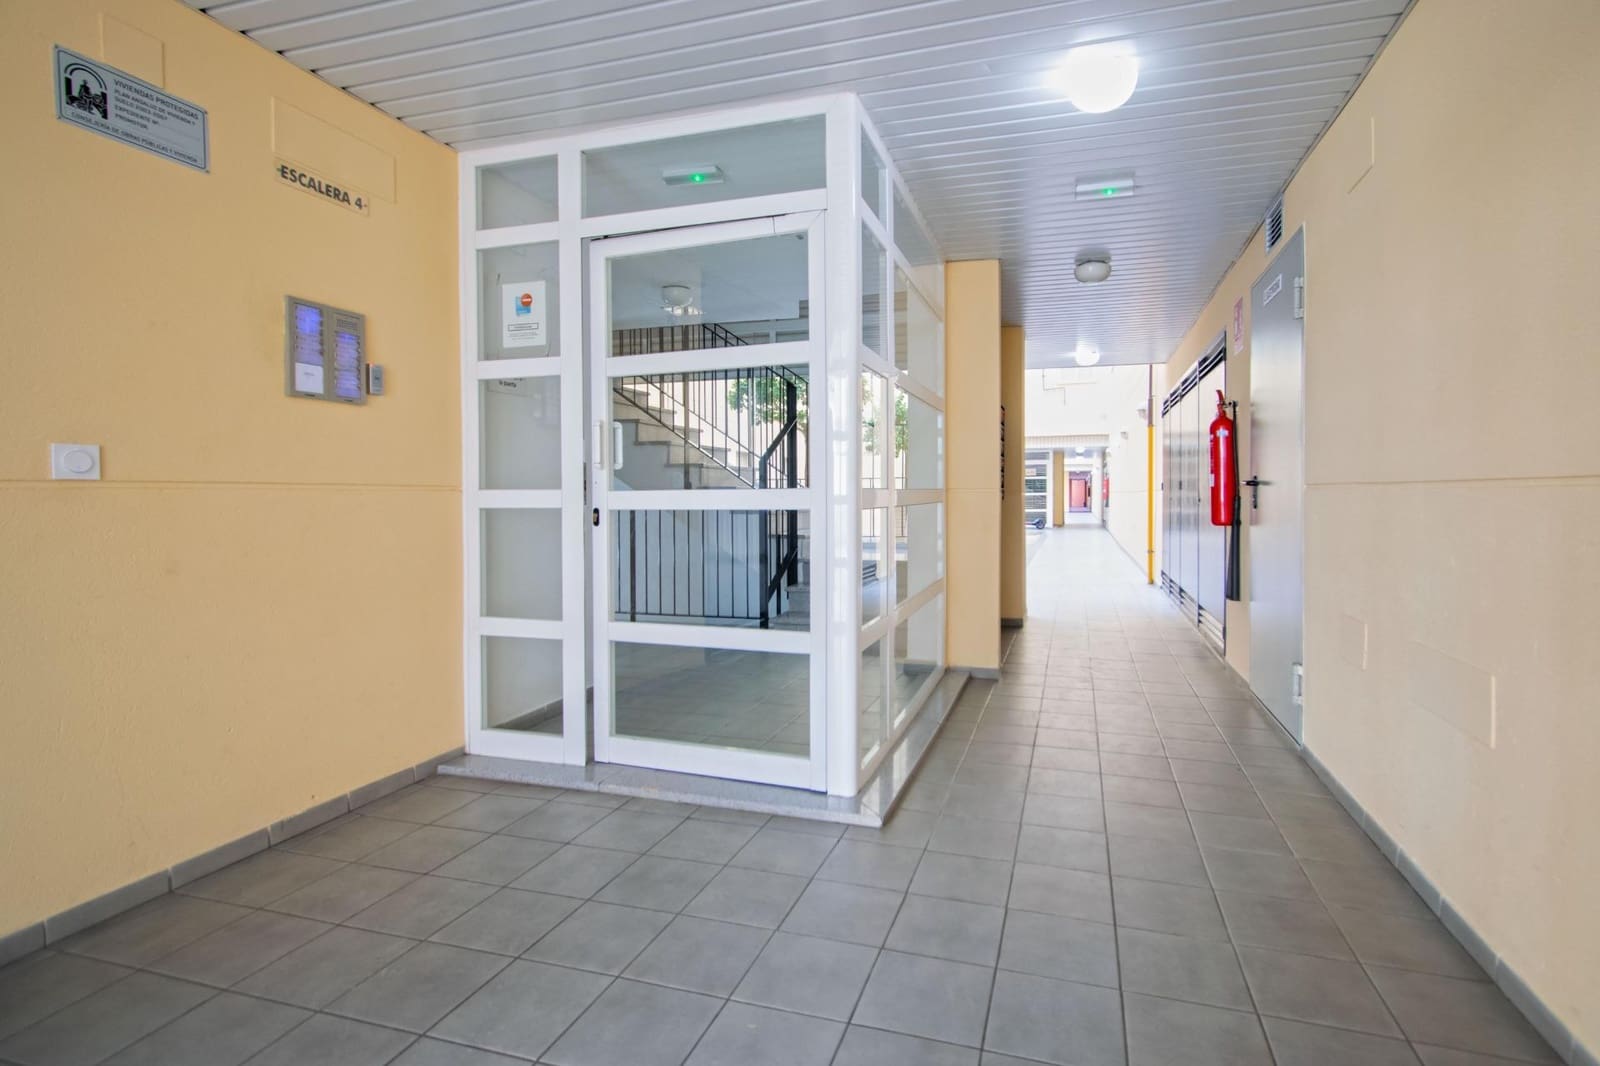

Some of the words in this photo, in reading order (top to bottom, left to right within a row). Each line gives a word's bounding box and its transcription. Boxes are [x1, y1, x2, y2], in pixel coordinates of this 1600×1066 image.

[114, 79, 154, 102] VIVIENDAS
[155, 95, 199, 120] PROTEGIDAS
[280, 164, 351, 205] ESCALERA
[354, 197, 363, 210] 4
